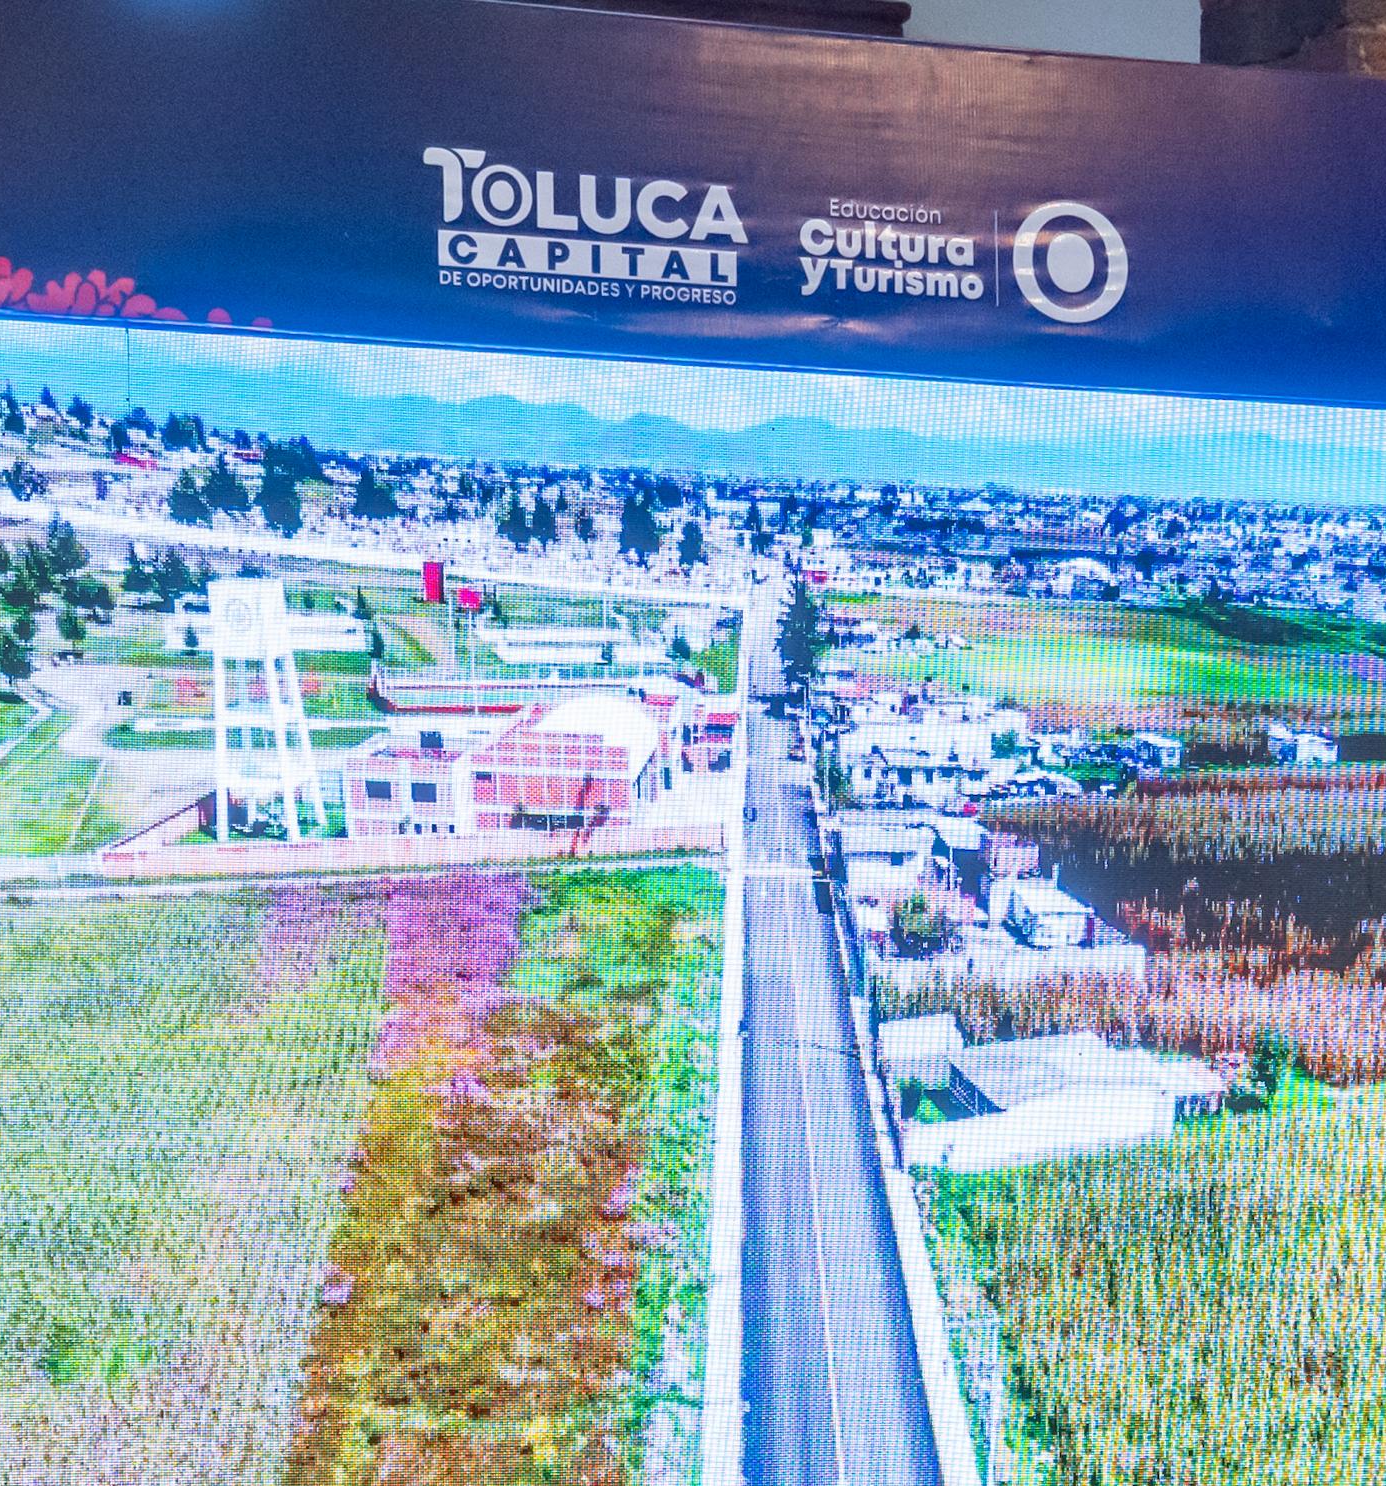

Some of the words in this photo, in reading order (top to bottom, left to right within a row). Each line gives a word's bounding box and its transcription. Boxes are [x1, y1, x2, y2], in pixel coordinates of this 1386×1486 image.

[422, 146, 749, 245] TOLUCA
[829, 198, 942, 225] Educación
[447, 234, 732, 284] CAPITAL
[800, 218, 975, 266] Cultura
[439, 273, 462, 288] DE
[467, 274, 620, 299] OPORTUNIDADES
[625, 284, 636, 299] Y
[641, 286, 738, 306] PROGRESO
